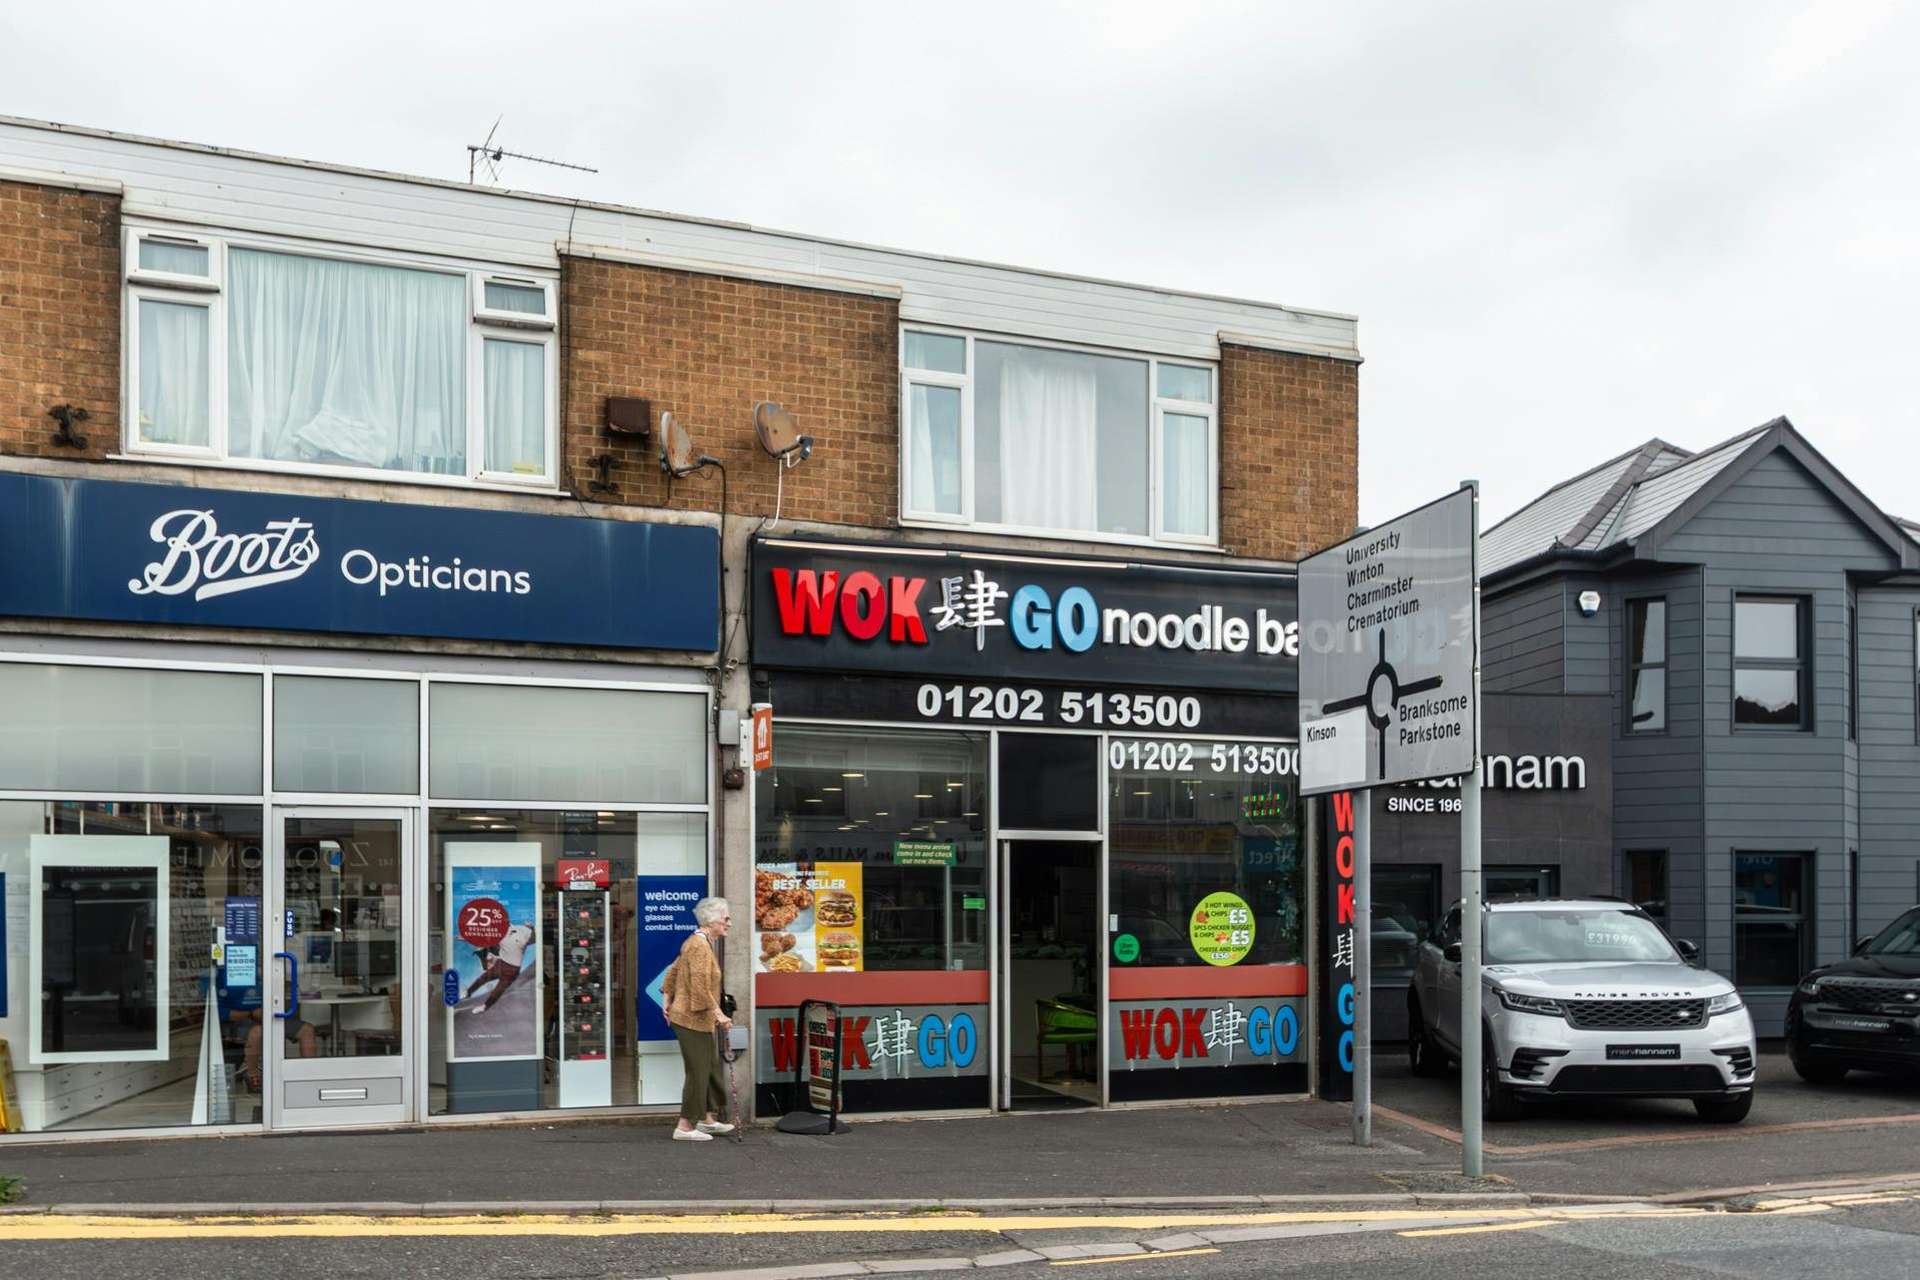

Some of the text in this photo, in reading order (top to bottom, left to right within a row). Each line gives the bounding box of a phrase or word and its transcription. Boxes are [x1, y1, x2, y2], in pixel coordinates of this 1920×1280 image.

[128, 509, 531, 601] Boots Opticians
[1346, 530, 1401, 565] University
[1346, 561, 1384, 588] Winton
[1347, 574, 1414, 610] Charminster
[772, 567, 928, 644] WOK
[1011, 584, 1099, 653] GO
[1102, 604, 1249, 653] noodle
[1256, 608, 1298, 657] ba
[1347, 598, 1420, 633] Crematorium
[917, 684, 1201, 728] 01202 513500
[1399, 694, 1468, 722] Branksome
[1306, 724, 1337, 742] Kinson
[1399, 722, 1461, 747] Parkstone
[1109, 741, 1194, 772] 01202
[1388, 797, 1462, 812] SINCE 196
[644, 890, 700, 901] welcome
[773, 879, 847, 890] BEST SELLER
[644, 914, 674, 922] glasses
[659, 904, 686, 912] checks
[1229, 909, 1248, 924] £5
[644, 923, 674, 931] contact
[1231, 930, 1250, 945] £5
[768, 1016, 873, 1073] WK
[917, 1012, 978, 1069] GO
[1120, 1008, 1209, 1060] WOK
[1246, 1004, 1299, 1058] GO
